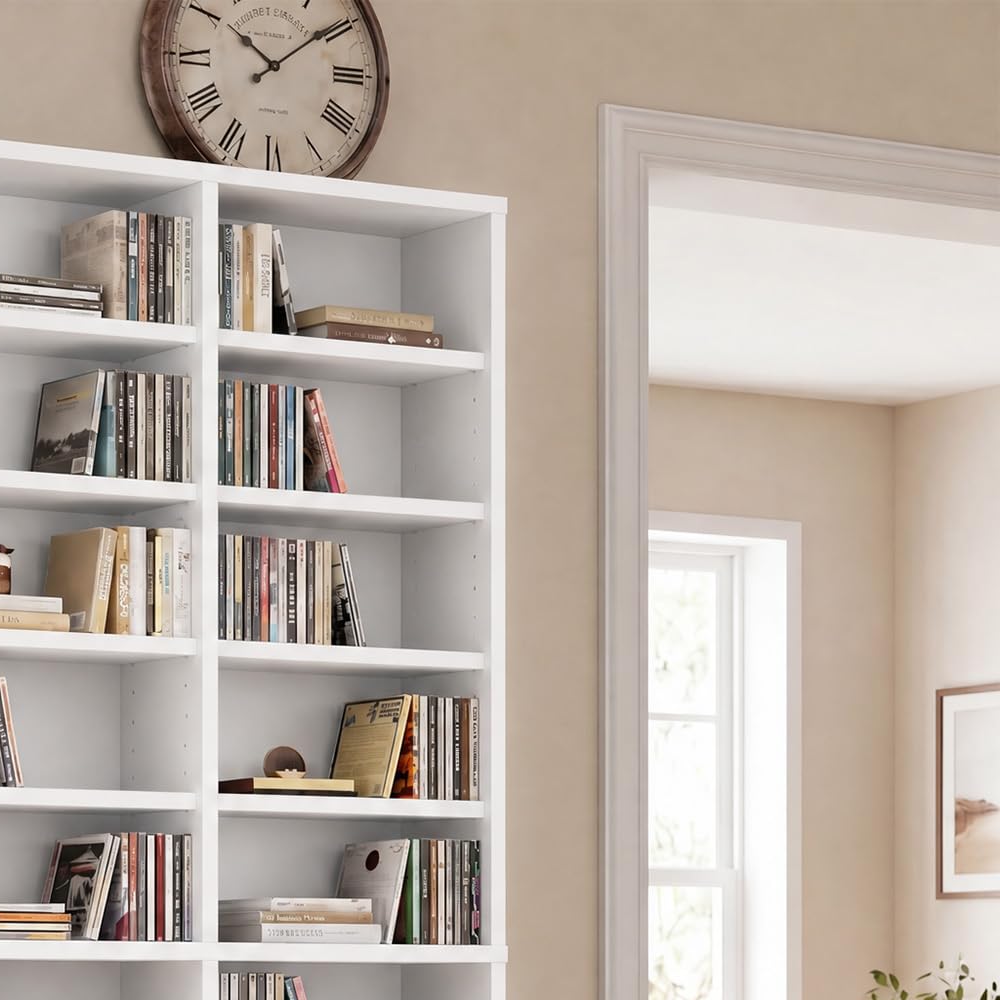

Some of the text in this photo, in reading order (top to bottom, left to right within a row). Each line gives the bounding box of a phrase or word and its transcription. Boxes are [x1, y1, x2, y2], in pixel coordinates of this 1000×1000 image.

[333, 64, 363, 86] III
[187, 82, 223, 123] VIII
[218, 117, 247, 160] VII
